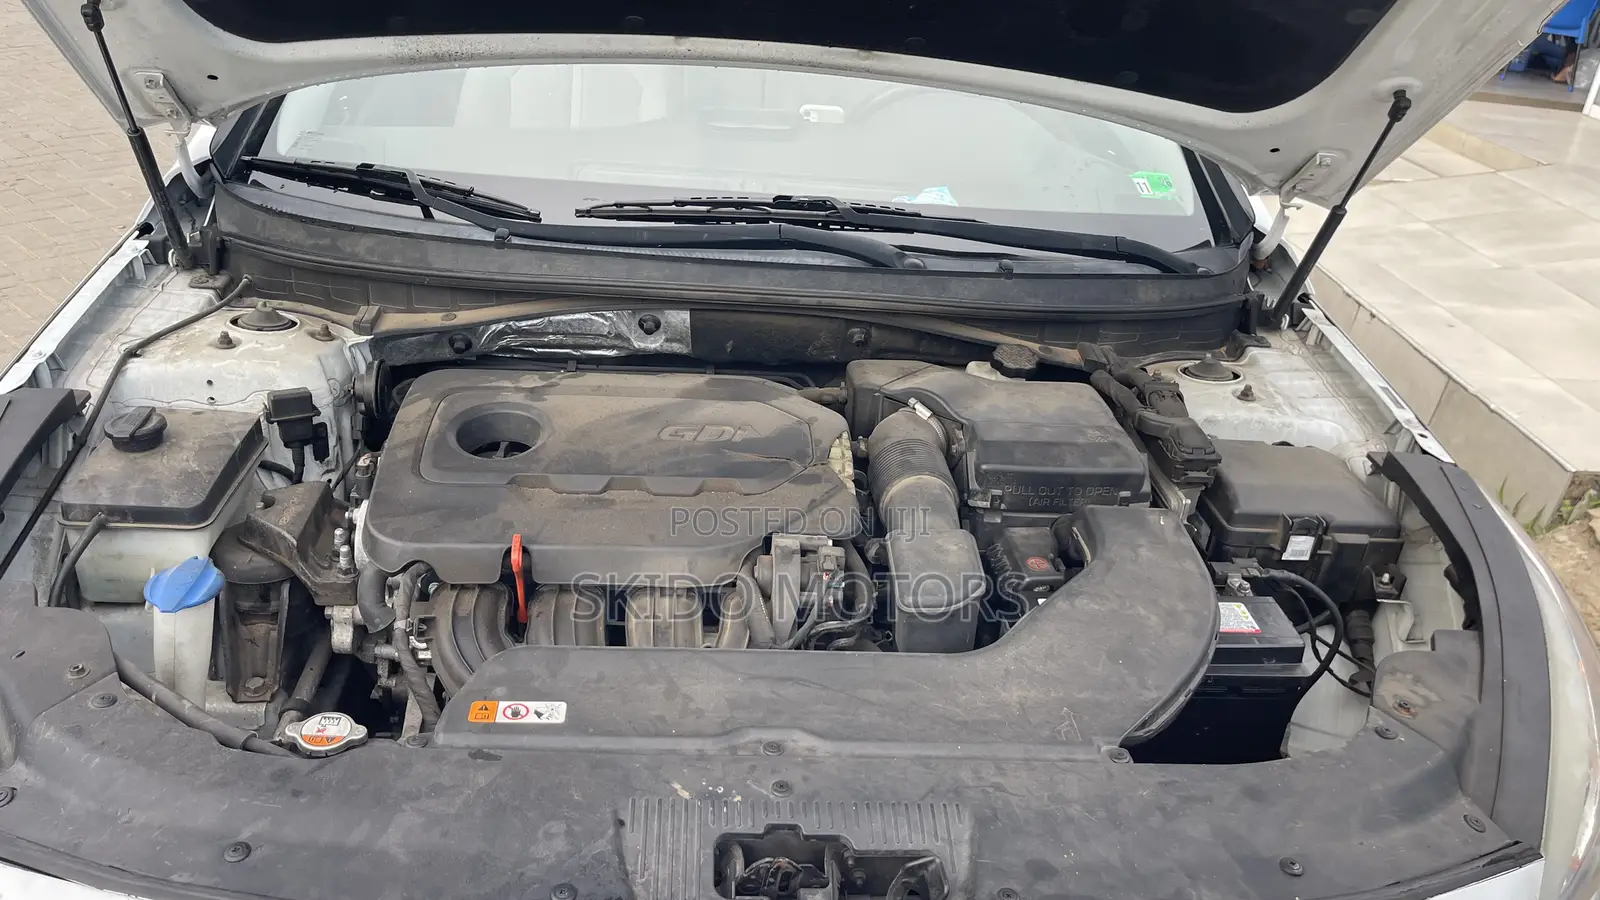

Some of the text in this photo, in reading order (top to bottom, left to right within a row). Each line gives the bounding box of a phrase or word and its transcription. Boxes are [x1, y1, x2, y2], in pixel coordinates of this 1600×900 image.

[1003, 485, 1118, 496] PULL OUT TO OPEN
